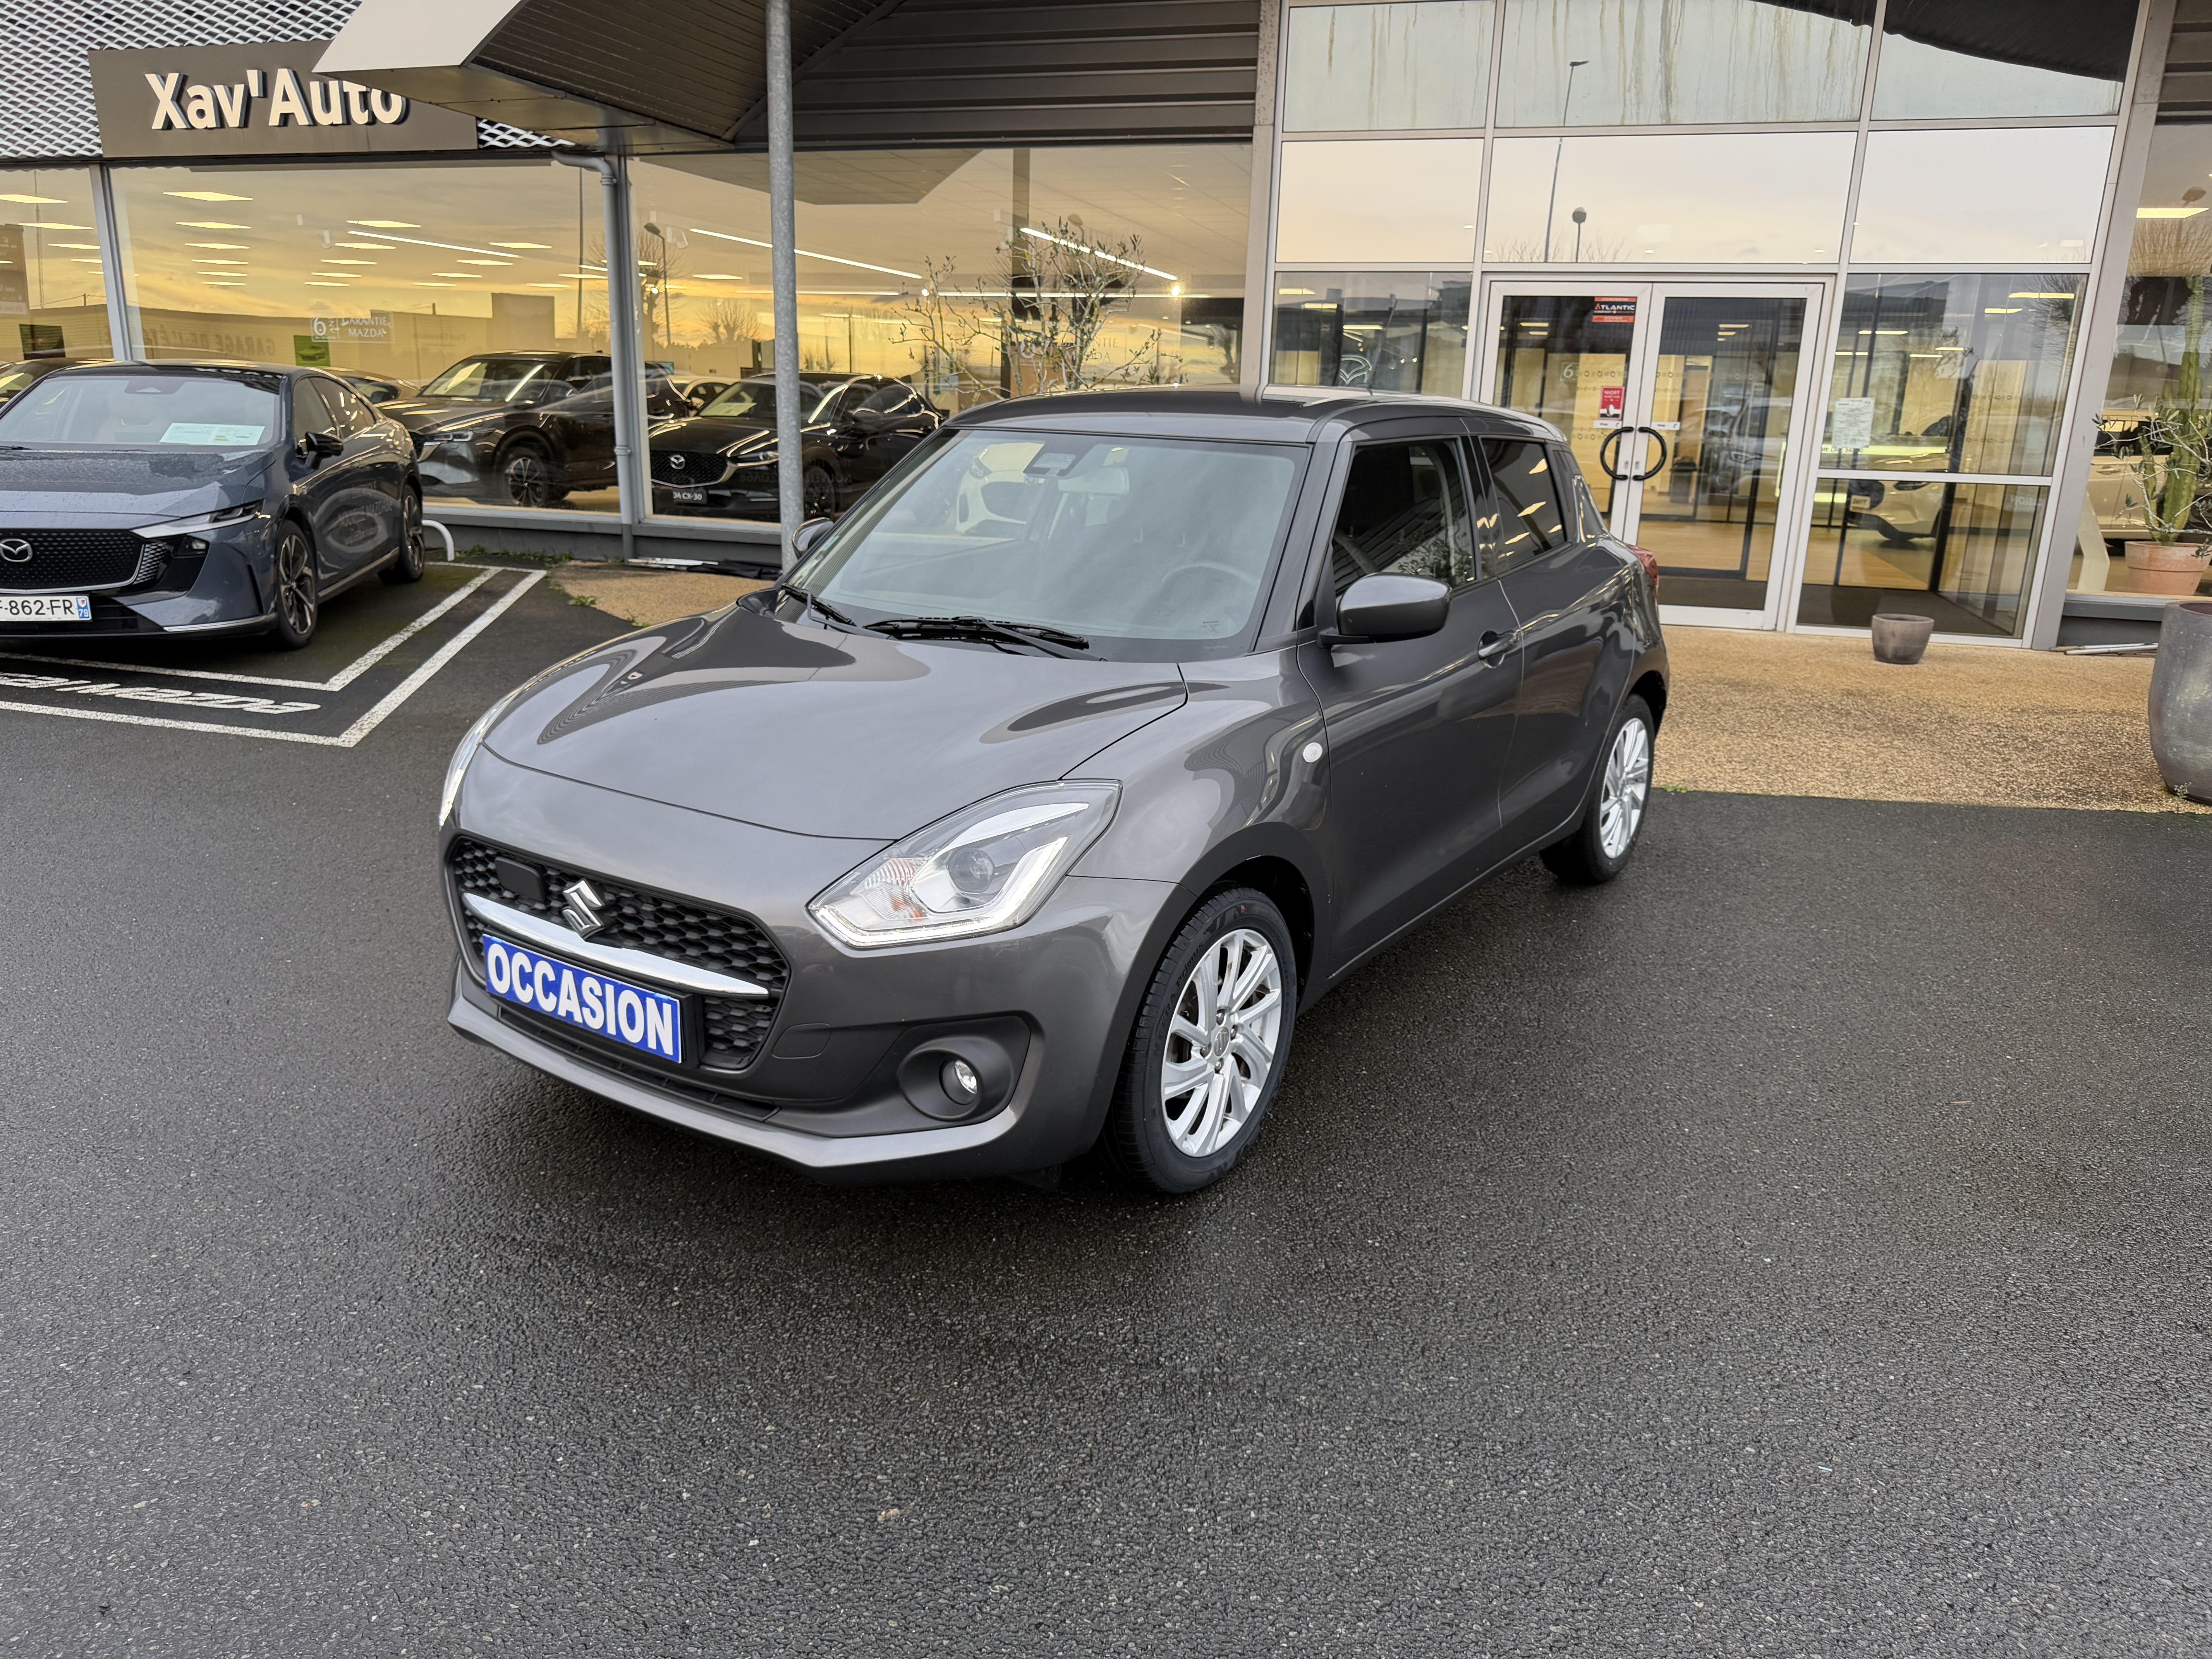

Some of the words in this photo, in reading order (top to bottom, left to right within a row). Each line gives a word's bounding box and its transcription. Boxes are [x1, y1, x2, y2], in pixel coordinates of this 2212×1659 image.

[145, 68, 405, 130] Xav'Auto
[348, 328, 385, 338] MAZDA
[1563, 364, 1573, 378] 6
[488, 943, 674, 1056] OCCASION
